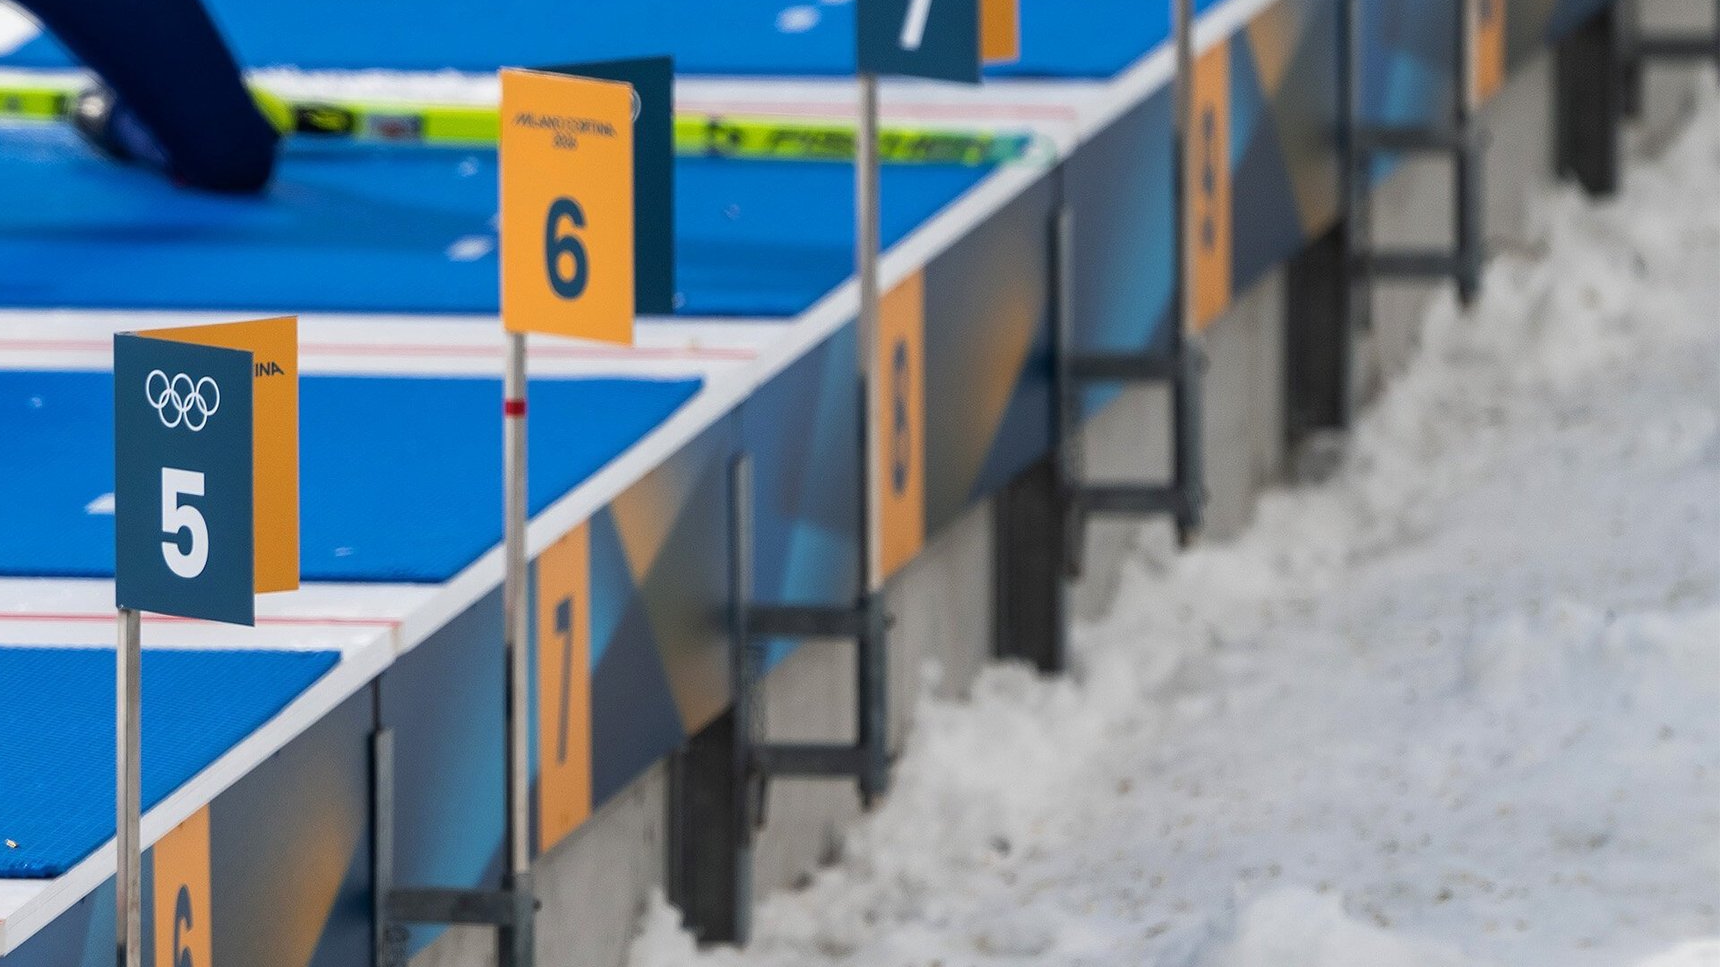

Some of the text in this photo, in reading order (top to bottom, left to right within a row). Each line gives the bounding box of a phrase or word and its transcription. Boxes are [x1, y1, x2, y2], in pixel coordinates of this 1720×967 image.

[543, 196, 590, 300] 6
[160, 467, 210, 579] 5
[554, 595, 573, 767] 7
